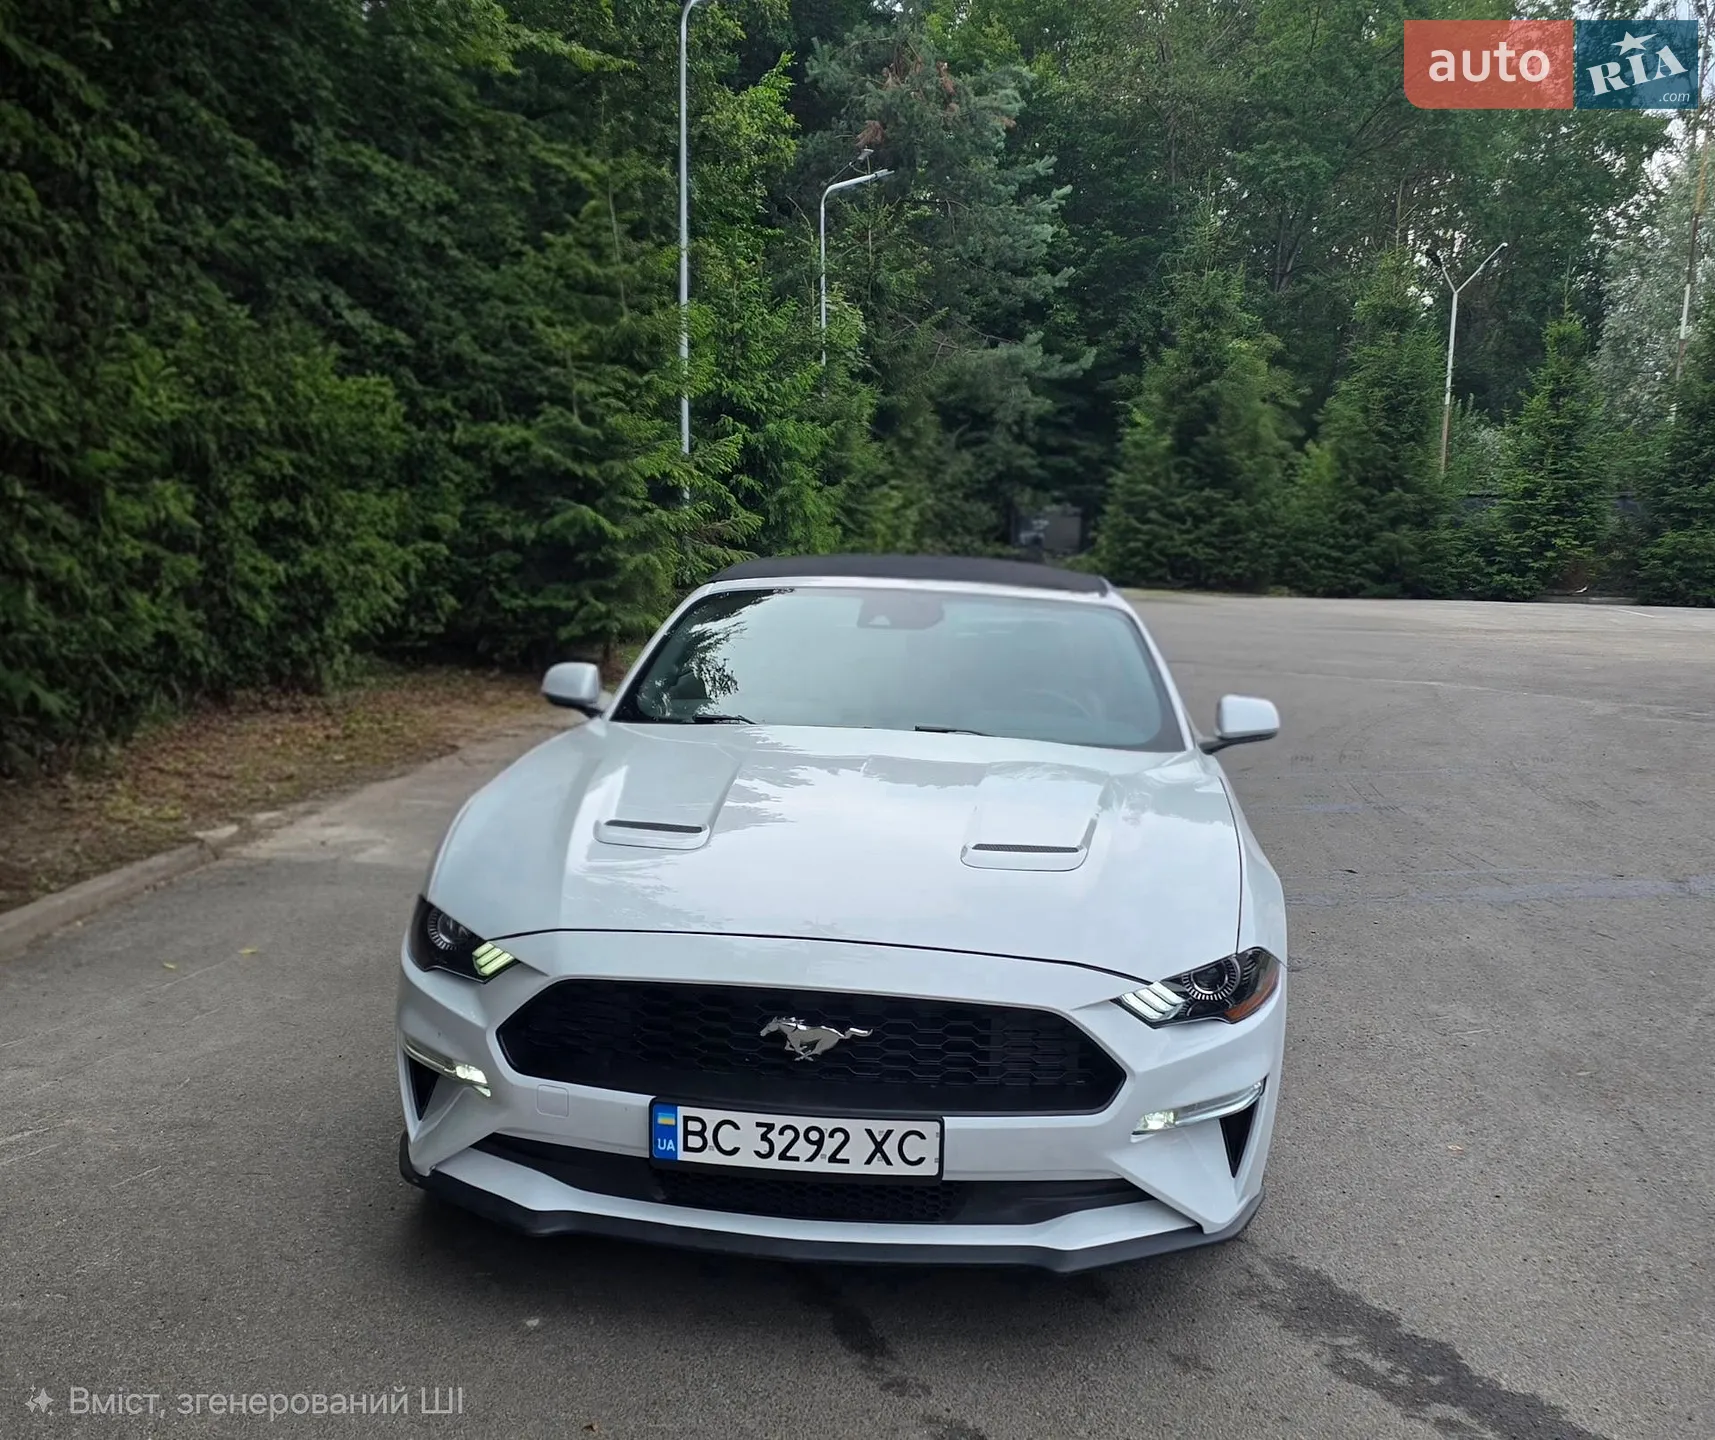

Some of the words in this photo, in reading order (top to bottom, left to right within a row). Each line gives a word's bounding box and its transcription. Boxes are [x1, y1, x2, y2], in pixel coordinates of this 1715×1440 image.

[657, 1138, 676, 1152] UA
[682, 1115, 741, 1156] BC
[753, 1121, 851, 1165] 3292
[863, 1128, 927, 1167] XC
